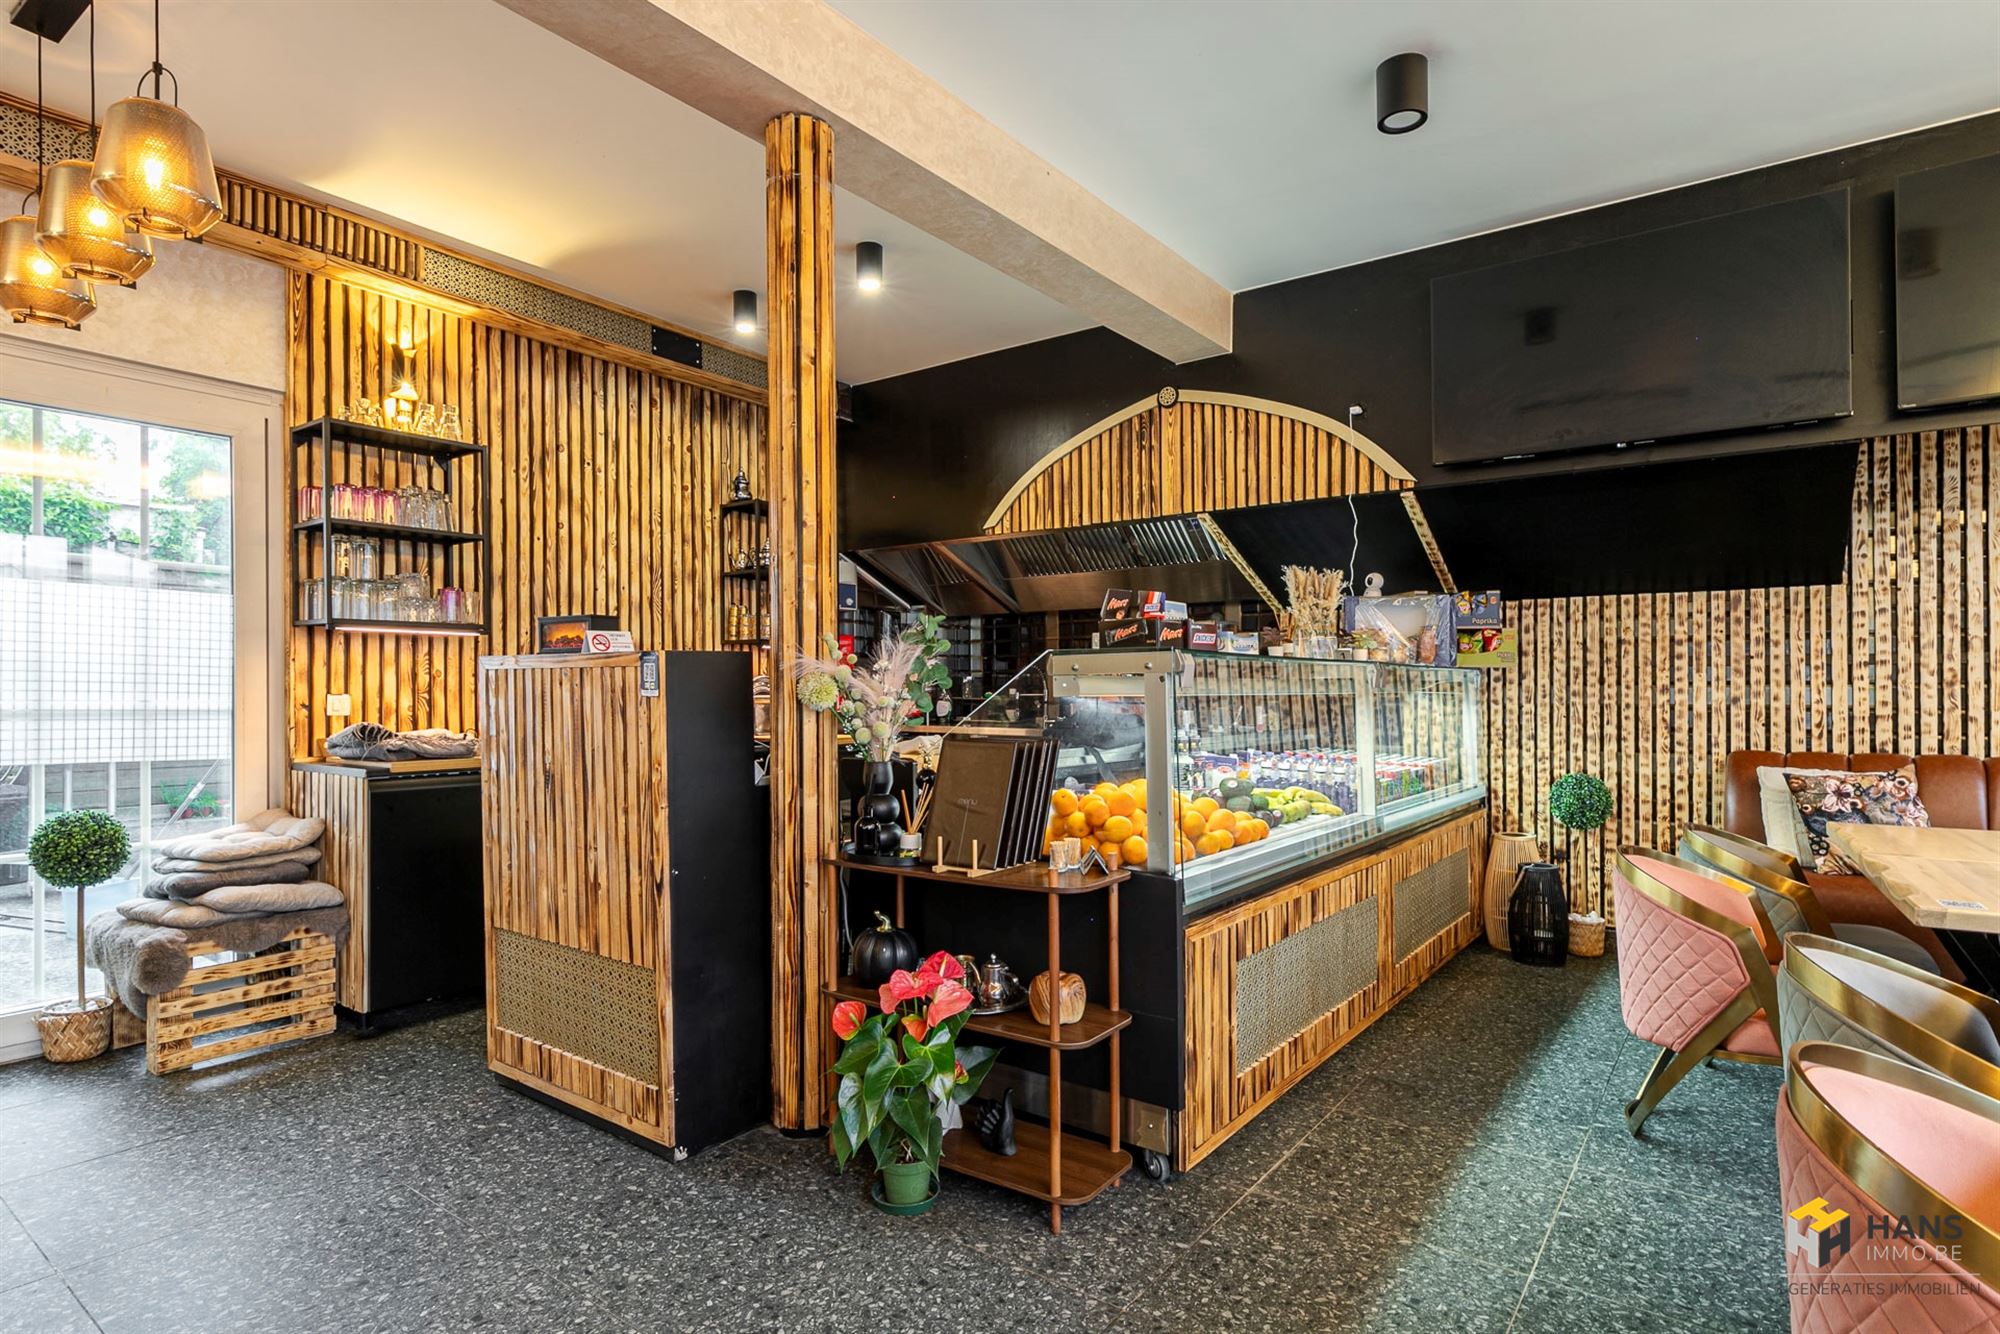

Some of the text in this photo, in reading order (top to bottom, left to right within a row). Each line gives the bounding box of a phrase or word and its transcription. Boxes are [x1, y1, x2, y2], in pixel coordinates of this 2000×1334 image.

[1106, 597, 1129, 611] Mars
[1472, 617, 1498, 625] Paprika
[1114, 624, 1138, 641] Mars
[1159, 627, 1183, 641] Mars
